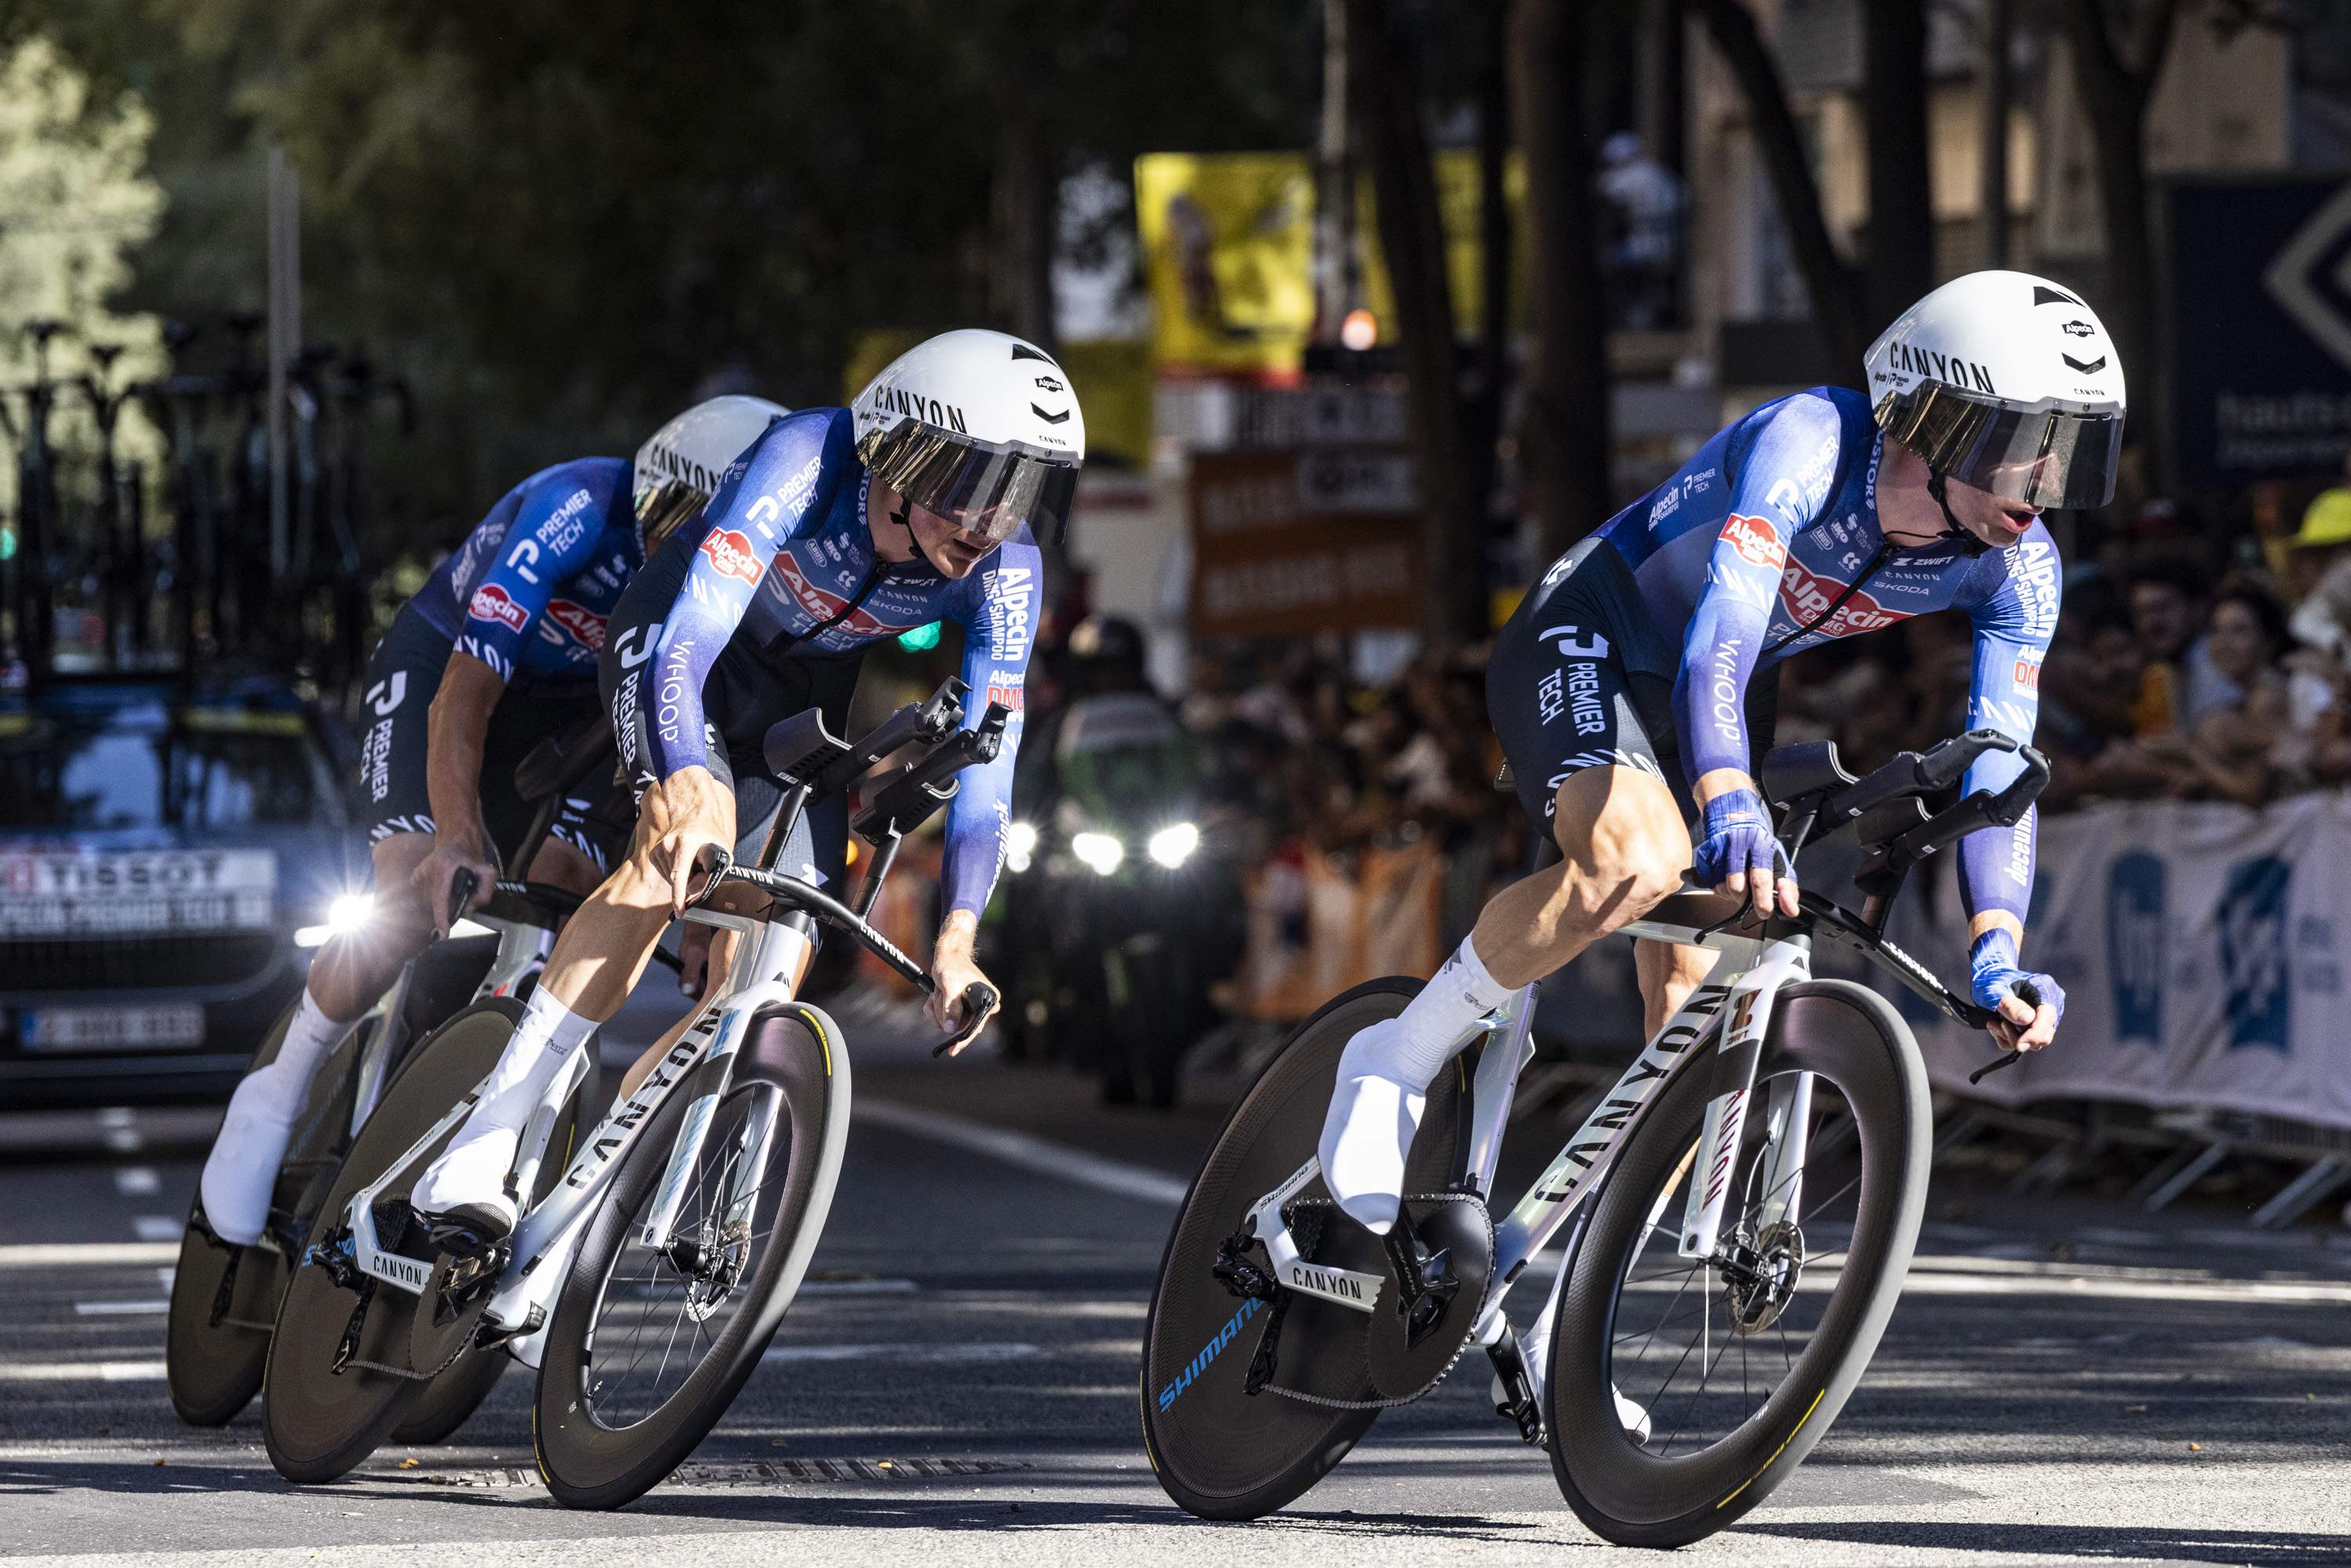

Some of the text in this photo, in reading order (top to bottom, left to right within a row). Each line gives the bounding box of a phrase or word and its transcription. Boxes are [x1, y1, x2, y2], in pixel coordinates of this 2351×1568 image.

[1890, 341, 1995, 394] CANYON
[875, 385, 967, 434] CANYON
[1039, 435, 1067, 446] CANYON
[1796, 435, 1839, 487] PREMIER
[777, 455, 825, 505] PREMIER
[1693, 468, 1716, 484] PREMIER
[1694, 480, 1709, 494] TECH
[1806, 468, 1834, 503] TECH
[535, 488, 593, 544] PREMIER
[787, 485, 819, 517] TECH
[1648, 486, 1679, 524] Alpecin
[548, 516, 585, 557] TECH
[706, 532, 759, 578] Alpecin
[1726, 519, 1784, 564] Alpecin
[1884, 571, 1940, 581] CANYON
[1914, 556, 1954, 566] ZWIFT
[877, 588, 929, 603] CANYON
[1784, 567, 1894, 628] Alpecin
[2020, 541, 2058, 638] Alpecin
[988, 603, 1006, 661] SHAMPOO
[998, 567, 1033, 661] Alpecin
[1538, 668, 1565, 726] TECH
[1567, 662, 1607, 737] PREMIER
[619, 670, 639, 771] PREMIER
[371, 718, 394, 804] PREMIER
[728, 865, 773, 885] CANYON
[566, 1008, 722, 1190] CANYON
[1534, 984, 1732, 1205] CANYON
[1260, 1165, 1309, 1210] SHIMANO
[373, 1255, 422, 1286] CANYON
[1293, 1266, 1362, 1300] CANYON
